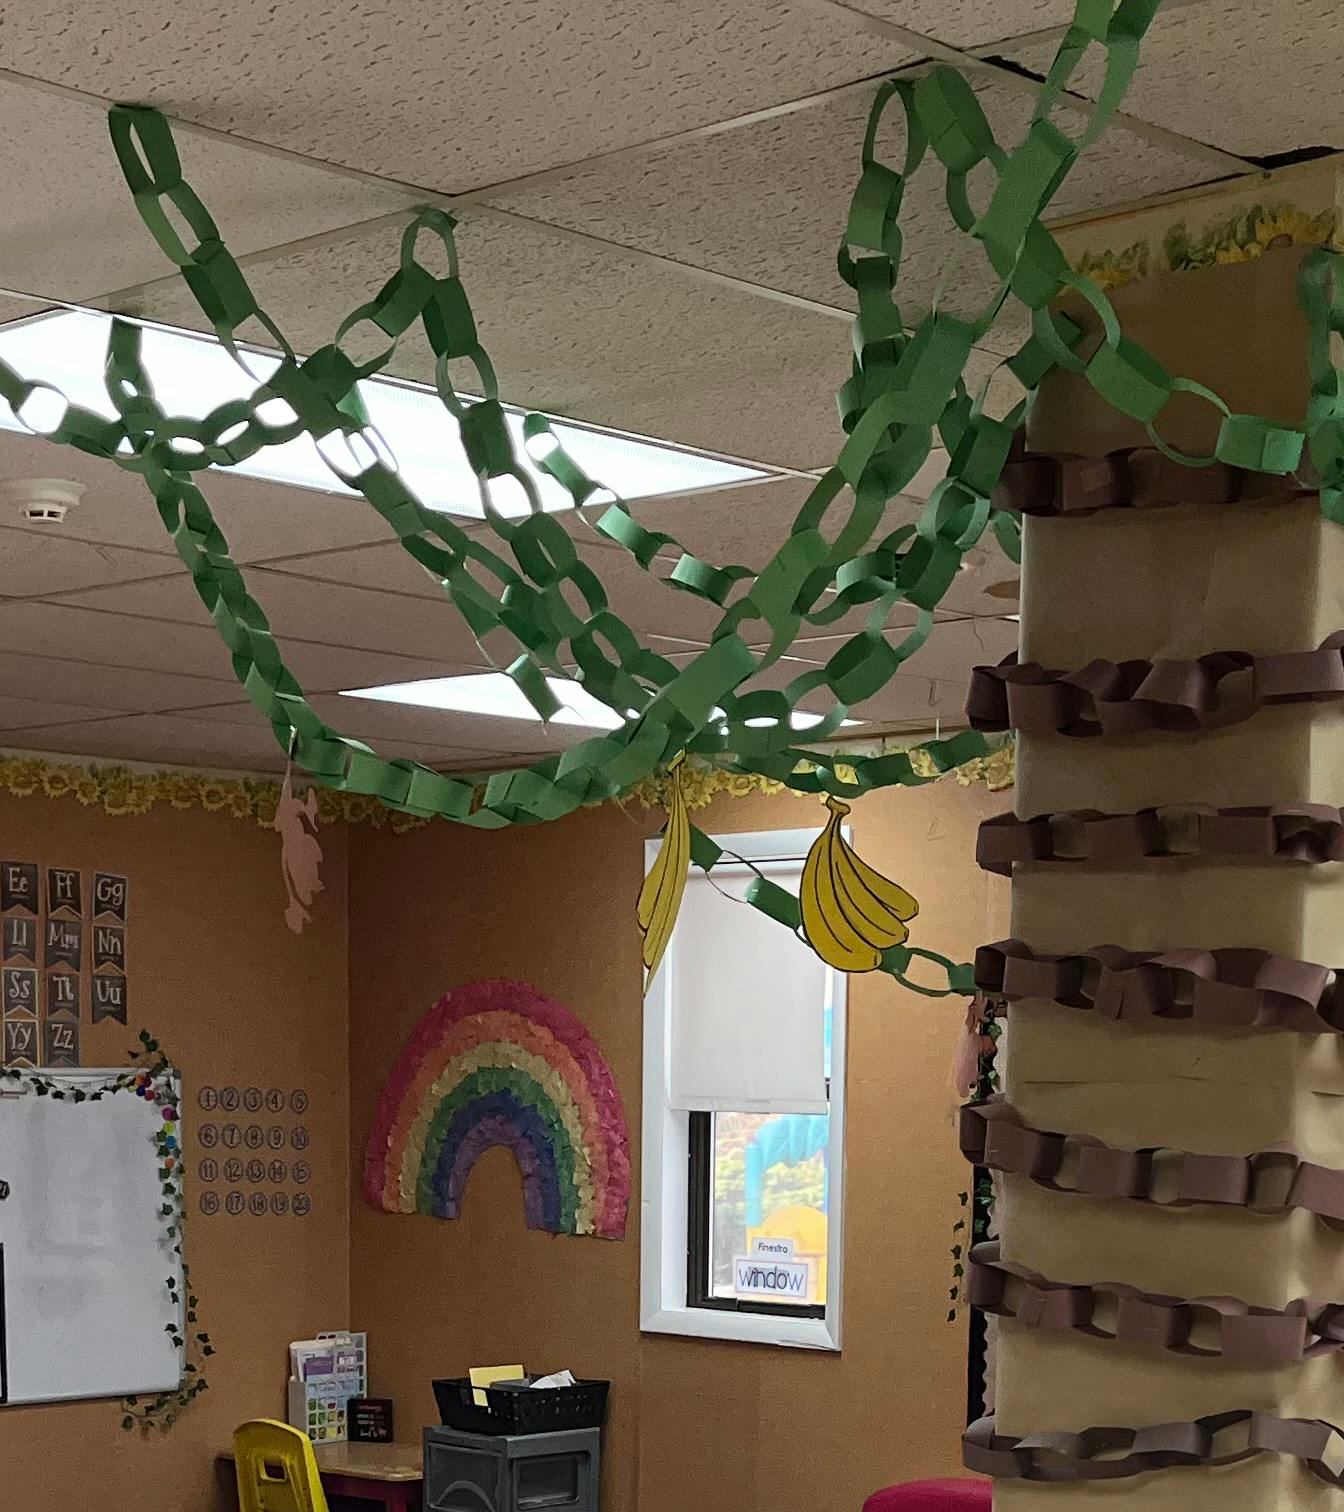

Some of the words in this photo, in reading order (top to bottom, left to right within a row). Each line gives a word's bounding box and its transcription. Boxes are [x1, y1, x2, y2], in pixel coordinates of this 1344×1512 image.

[8, 867, 28, 892] Ee
[55, 872, 75, 898] Ff
[97, 878, 124, 905] Gg
[12, 920, 27, 946] Ll
[47, 923, 79, 949] Mm
[98, 929, 122, 955] Nn
[9, 971, 31, 998] Ss
[53, 976, 75, 1001] Tt
[96, 979, 122, 1005] Uu
[8, 1023, 33, 1050] Yy
[51, 1024, 74, 1049] Zz
[758, 1242, 789, 1254] Finestra
[739, 1266, 805, 1291] window
